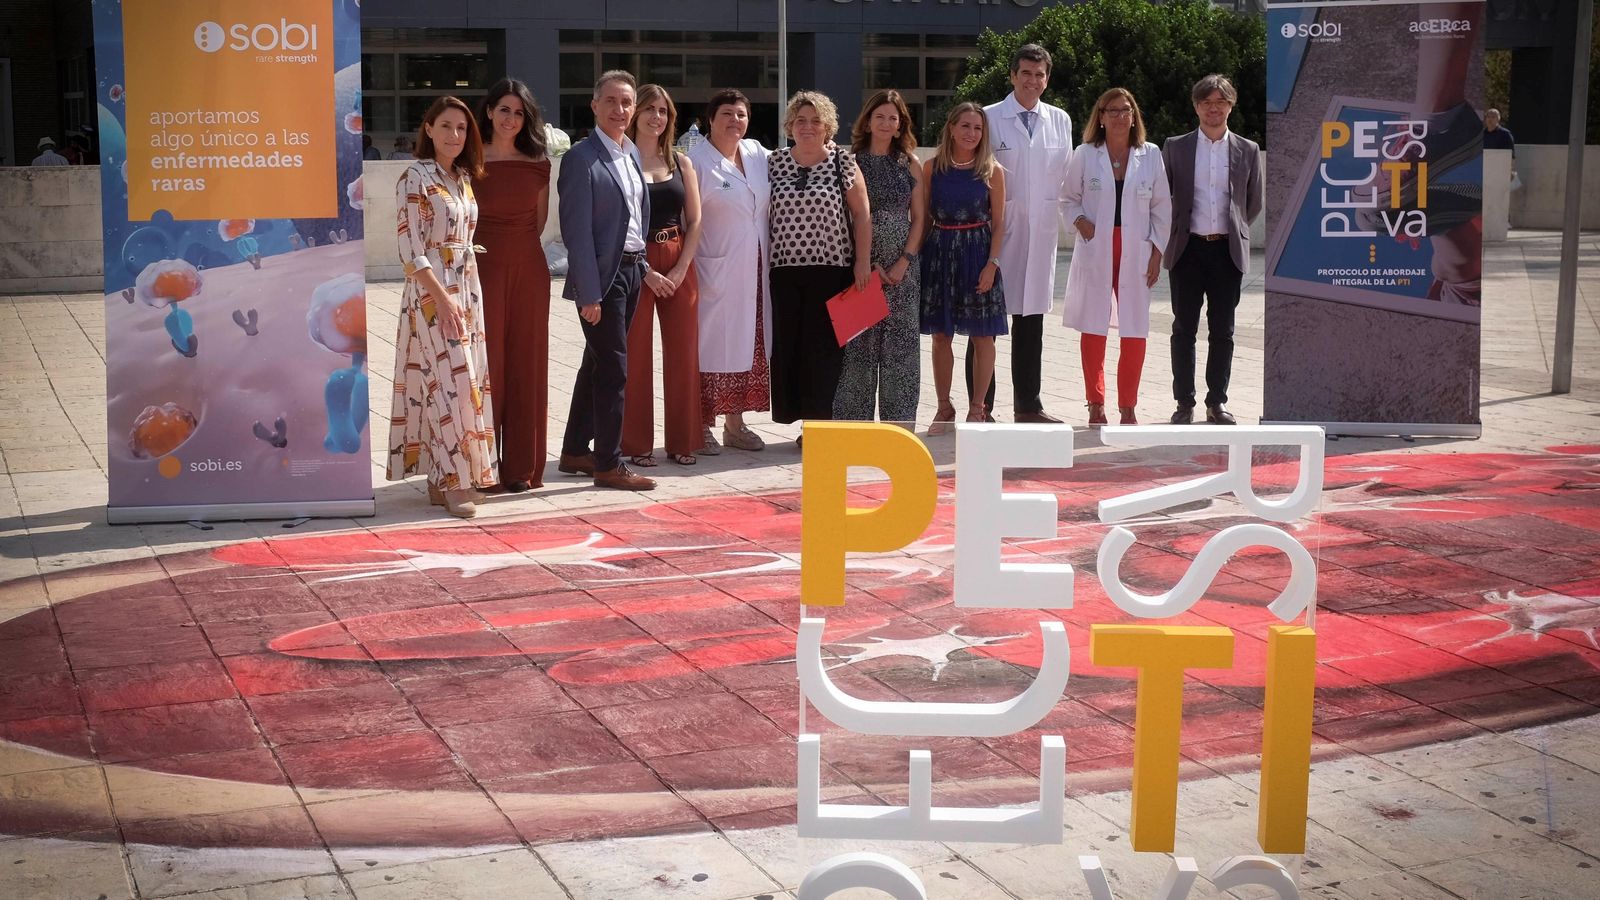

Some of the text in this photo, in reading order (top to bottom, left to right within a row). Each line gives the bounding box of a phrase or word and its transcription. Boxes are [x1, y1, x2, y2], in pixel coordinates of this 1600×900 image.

[229, 18, 317, 51] sobi
[1298, 20, 1342, 37] sobi
[255, 54, 318, 64] rare strength
[150, 109, 260, 129] aportamos
[151, 129, 310, 151] algo único a las
[151, 151, 304, 169] enfermedades
[151, 176, 206, 192] raras
[1381, 209, 1428, 238] va
[1317, 268, 1426, 276] PROTOCOLO DE ABORDAJE
[1332, 278, 1411, 286] INTEGRAL DE LA PTI
[190, 458, 242, 473] sobi.es
[1090, 624, 1316, 854] TI
